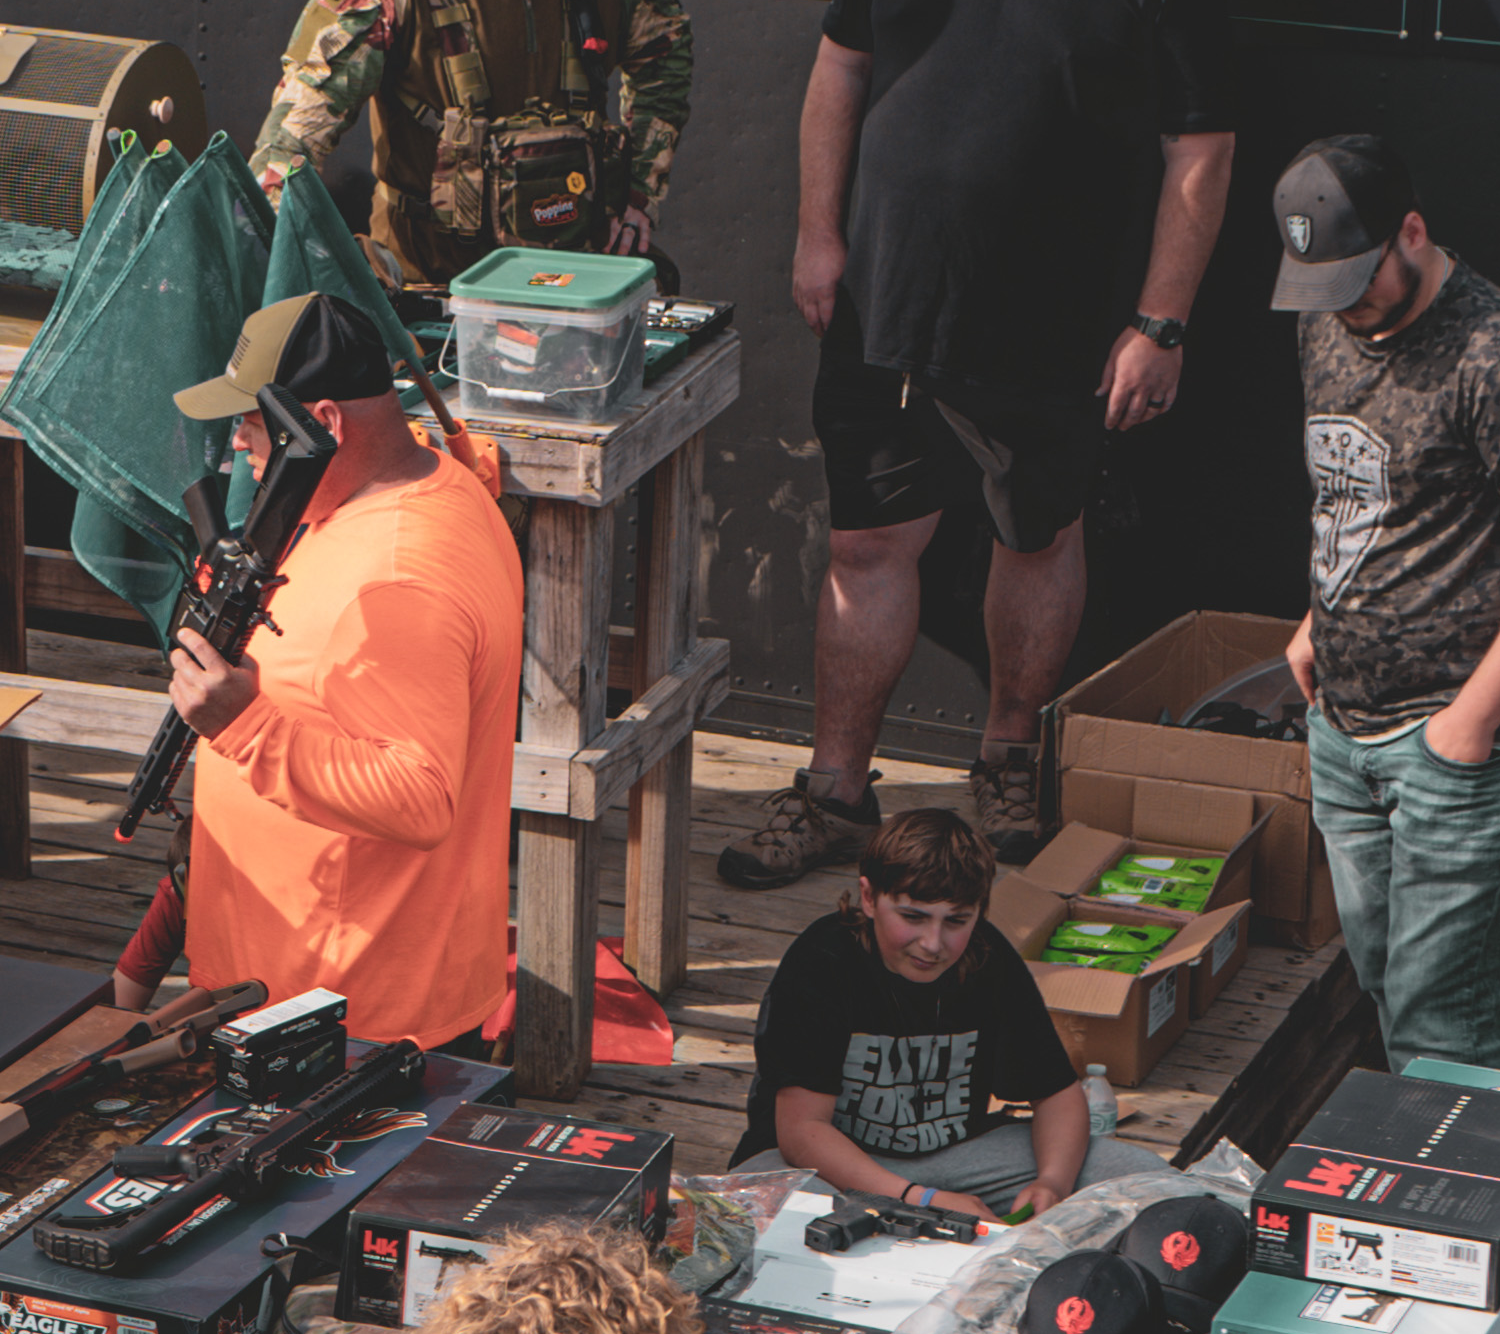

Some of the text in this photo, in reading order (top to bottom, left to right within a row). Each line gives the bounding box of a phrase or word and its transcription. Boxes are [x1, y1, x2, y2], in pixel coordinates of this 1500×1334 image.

[843, 1030, 978, 1086] ELITE
[834, 1075, 970, 1125] FORCE
[831, 1114, 968, 1152] AIRSOFT
